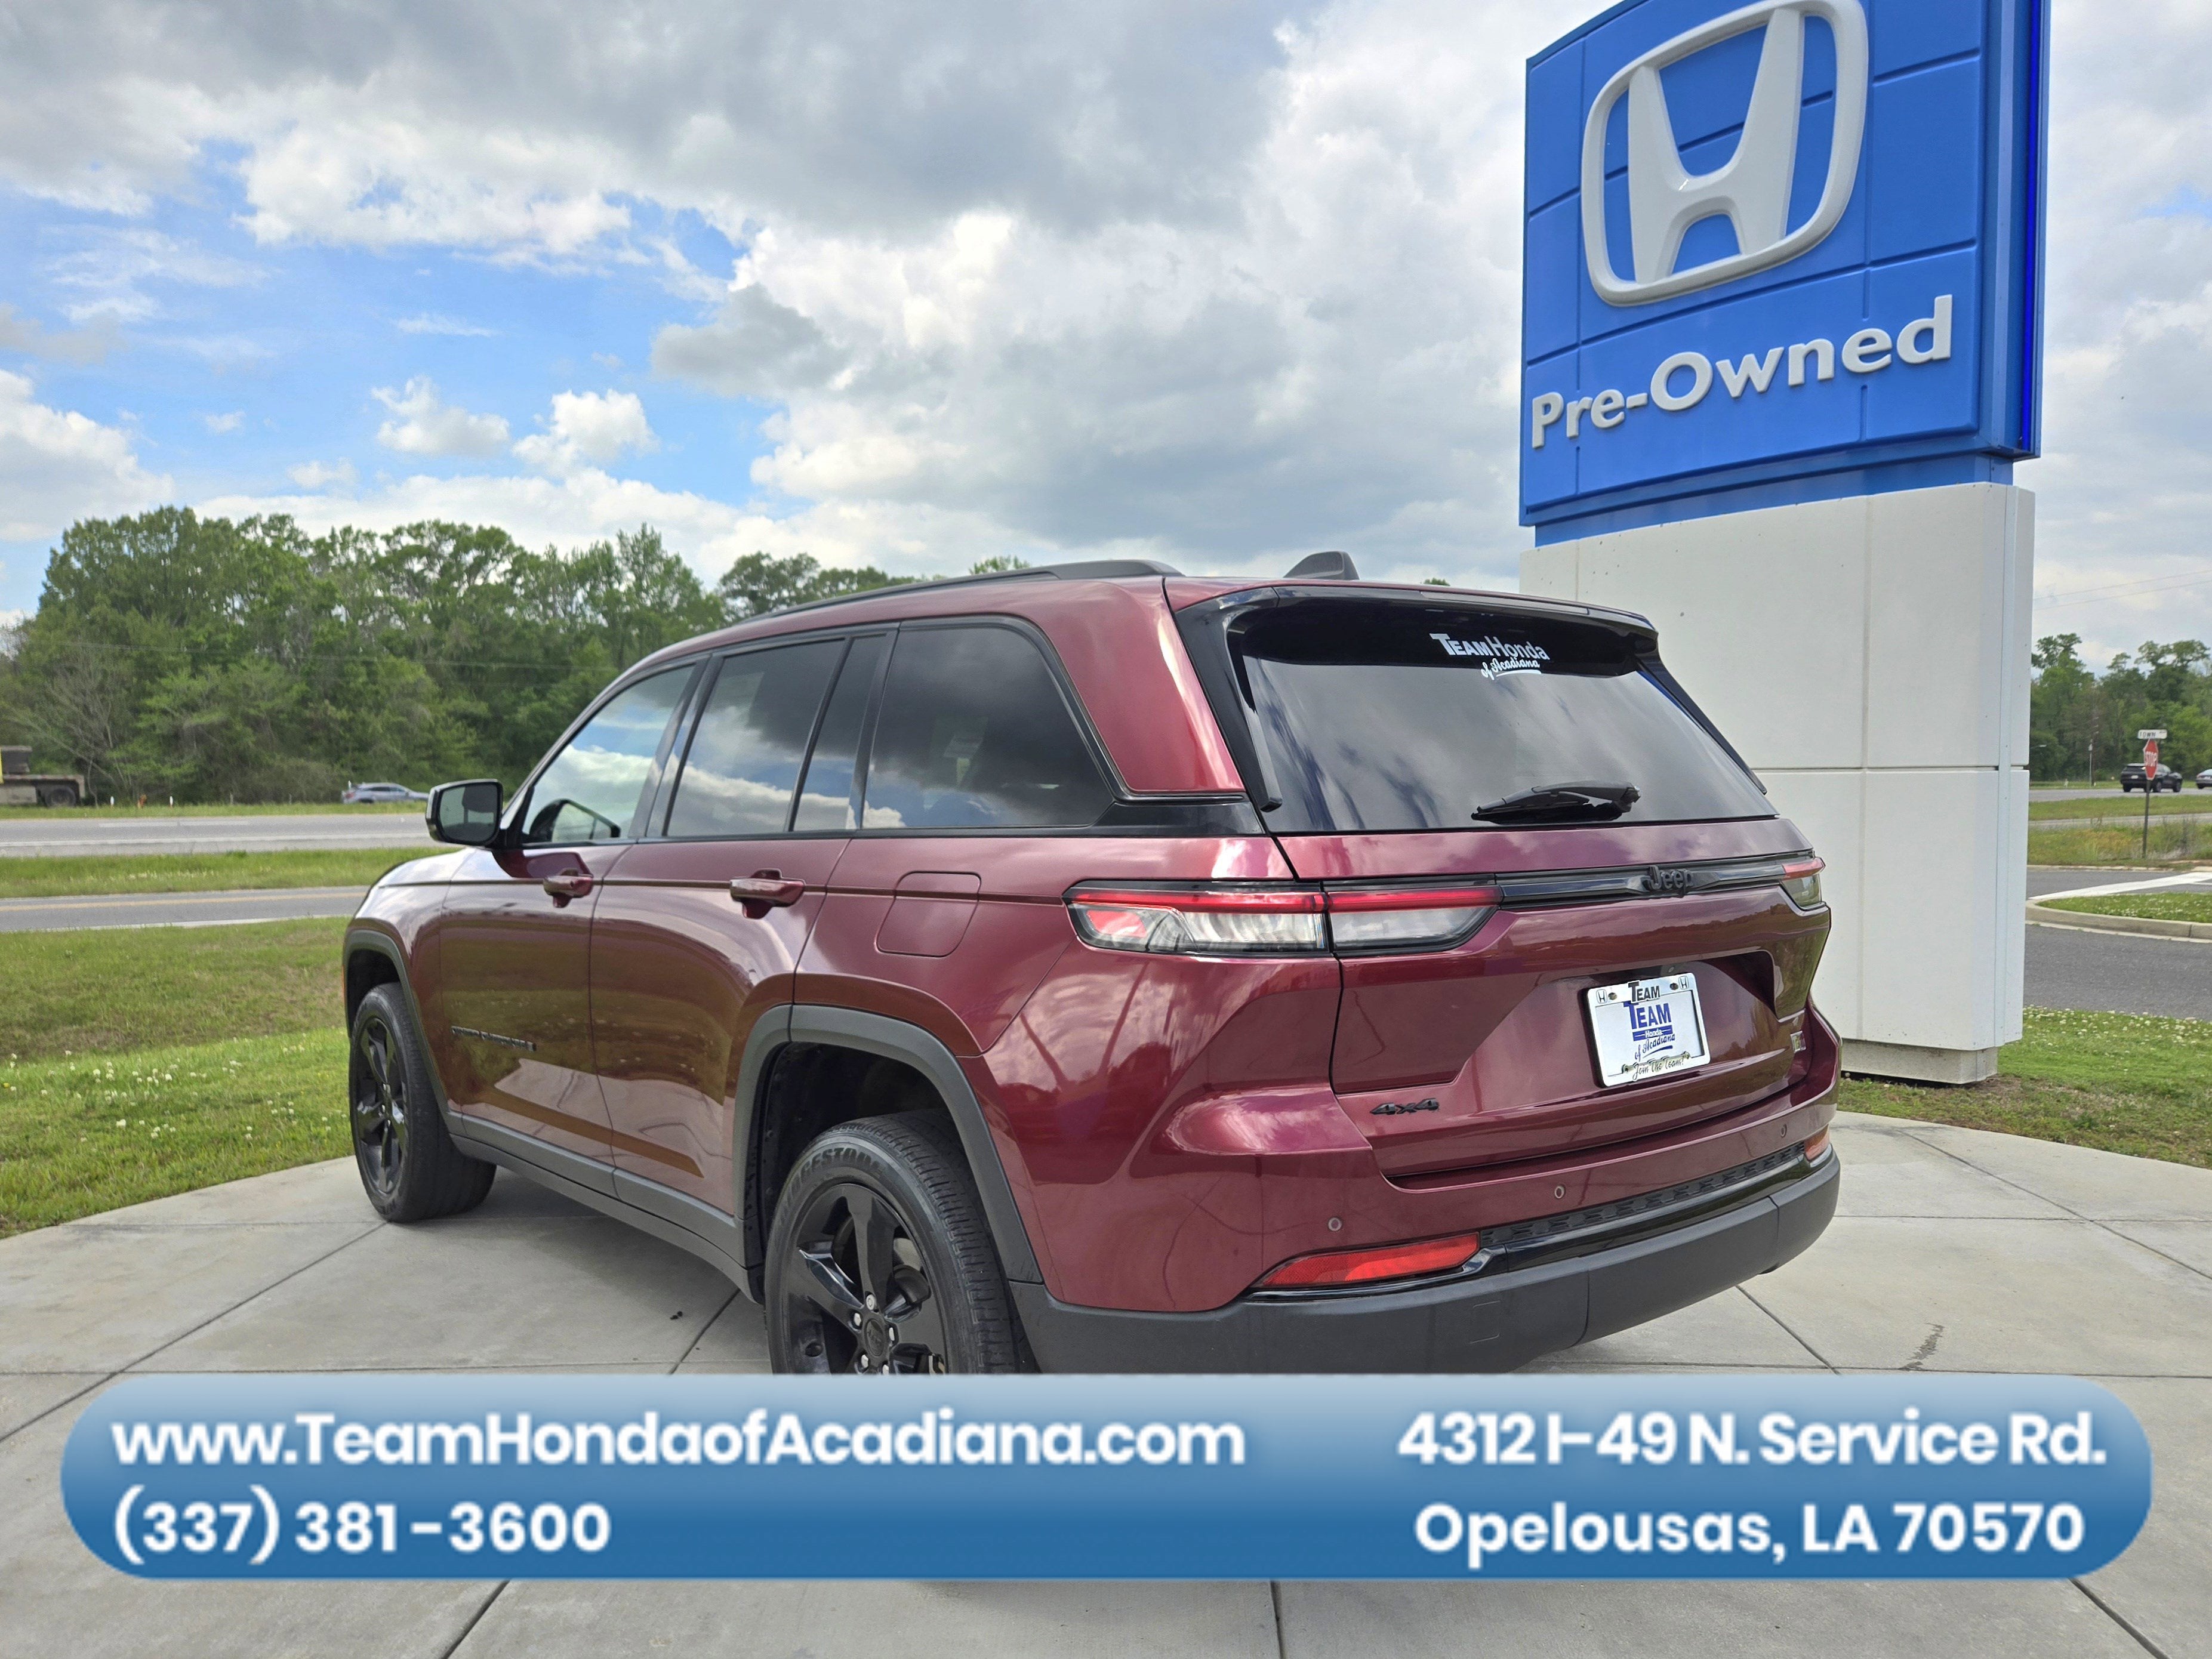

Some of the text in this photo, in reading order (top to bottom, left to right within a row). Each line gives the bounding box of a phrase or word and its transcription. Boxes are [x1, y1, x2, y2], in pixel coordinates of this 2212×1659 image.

[1531, 294, 1953, 449] Pre-Owned
[1480, 656, 1541, 680] of Acadiana
[2145, 751, 2157, 767] STOP
[1643, 865, 1693, 897] Jeep
[1628, 981, 1660, 1003] TEAM
[1623, 1001, 1672, 1029] TEAM
[1642, 1034, 1675, 1054] Acadiana
[1645, 1027, 1663, 1038] Honda
